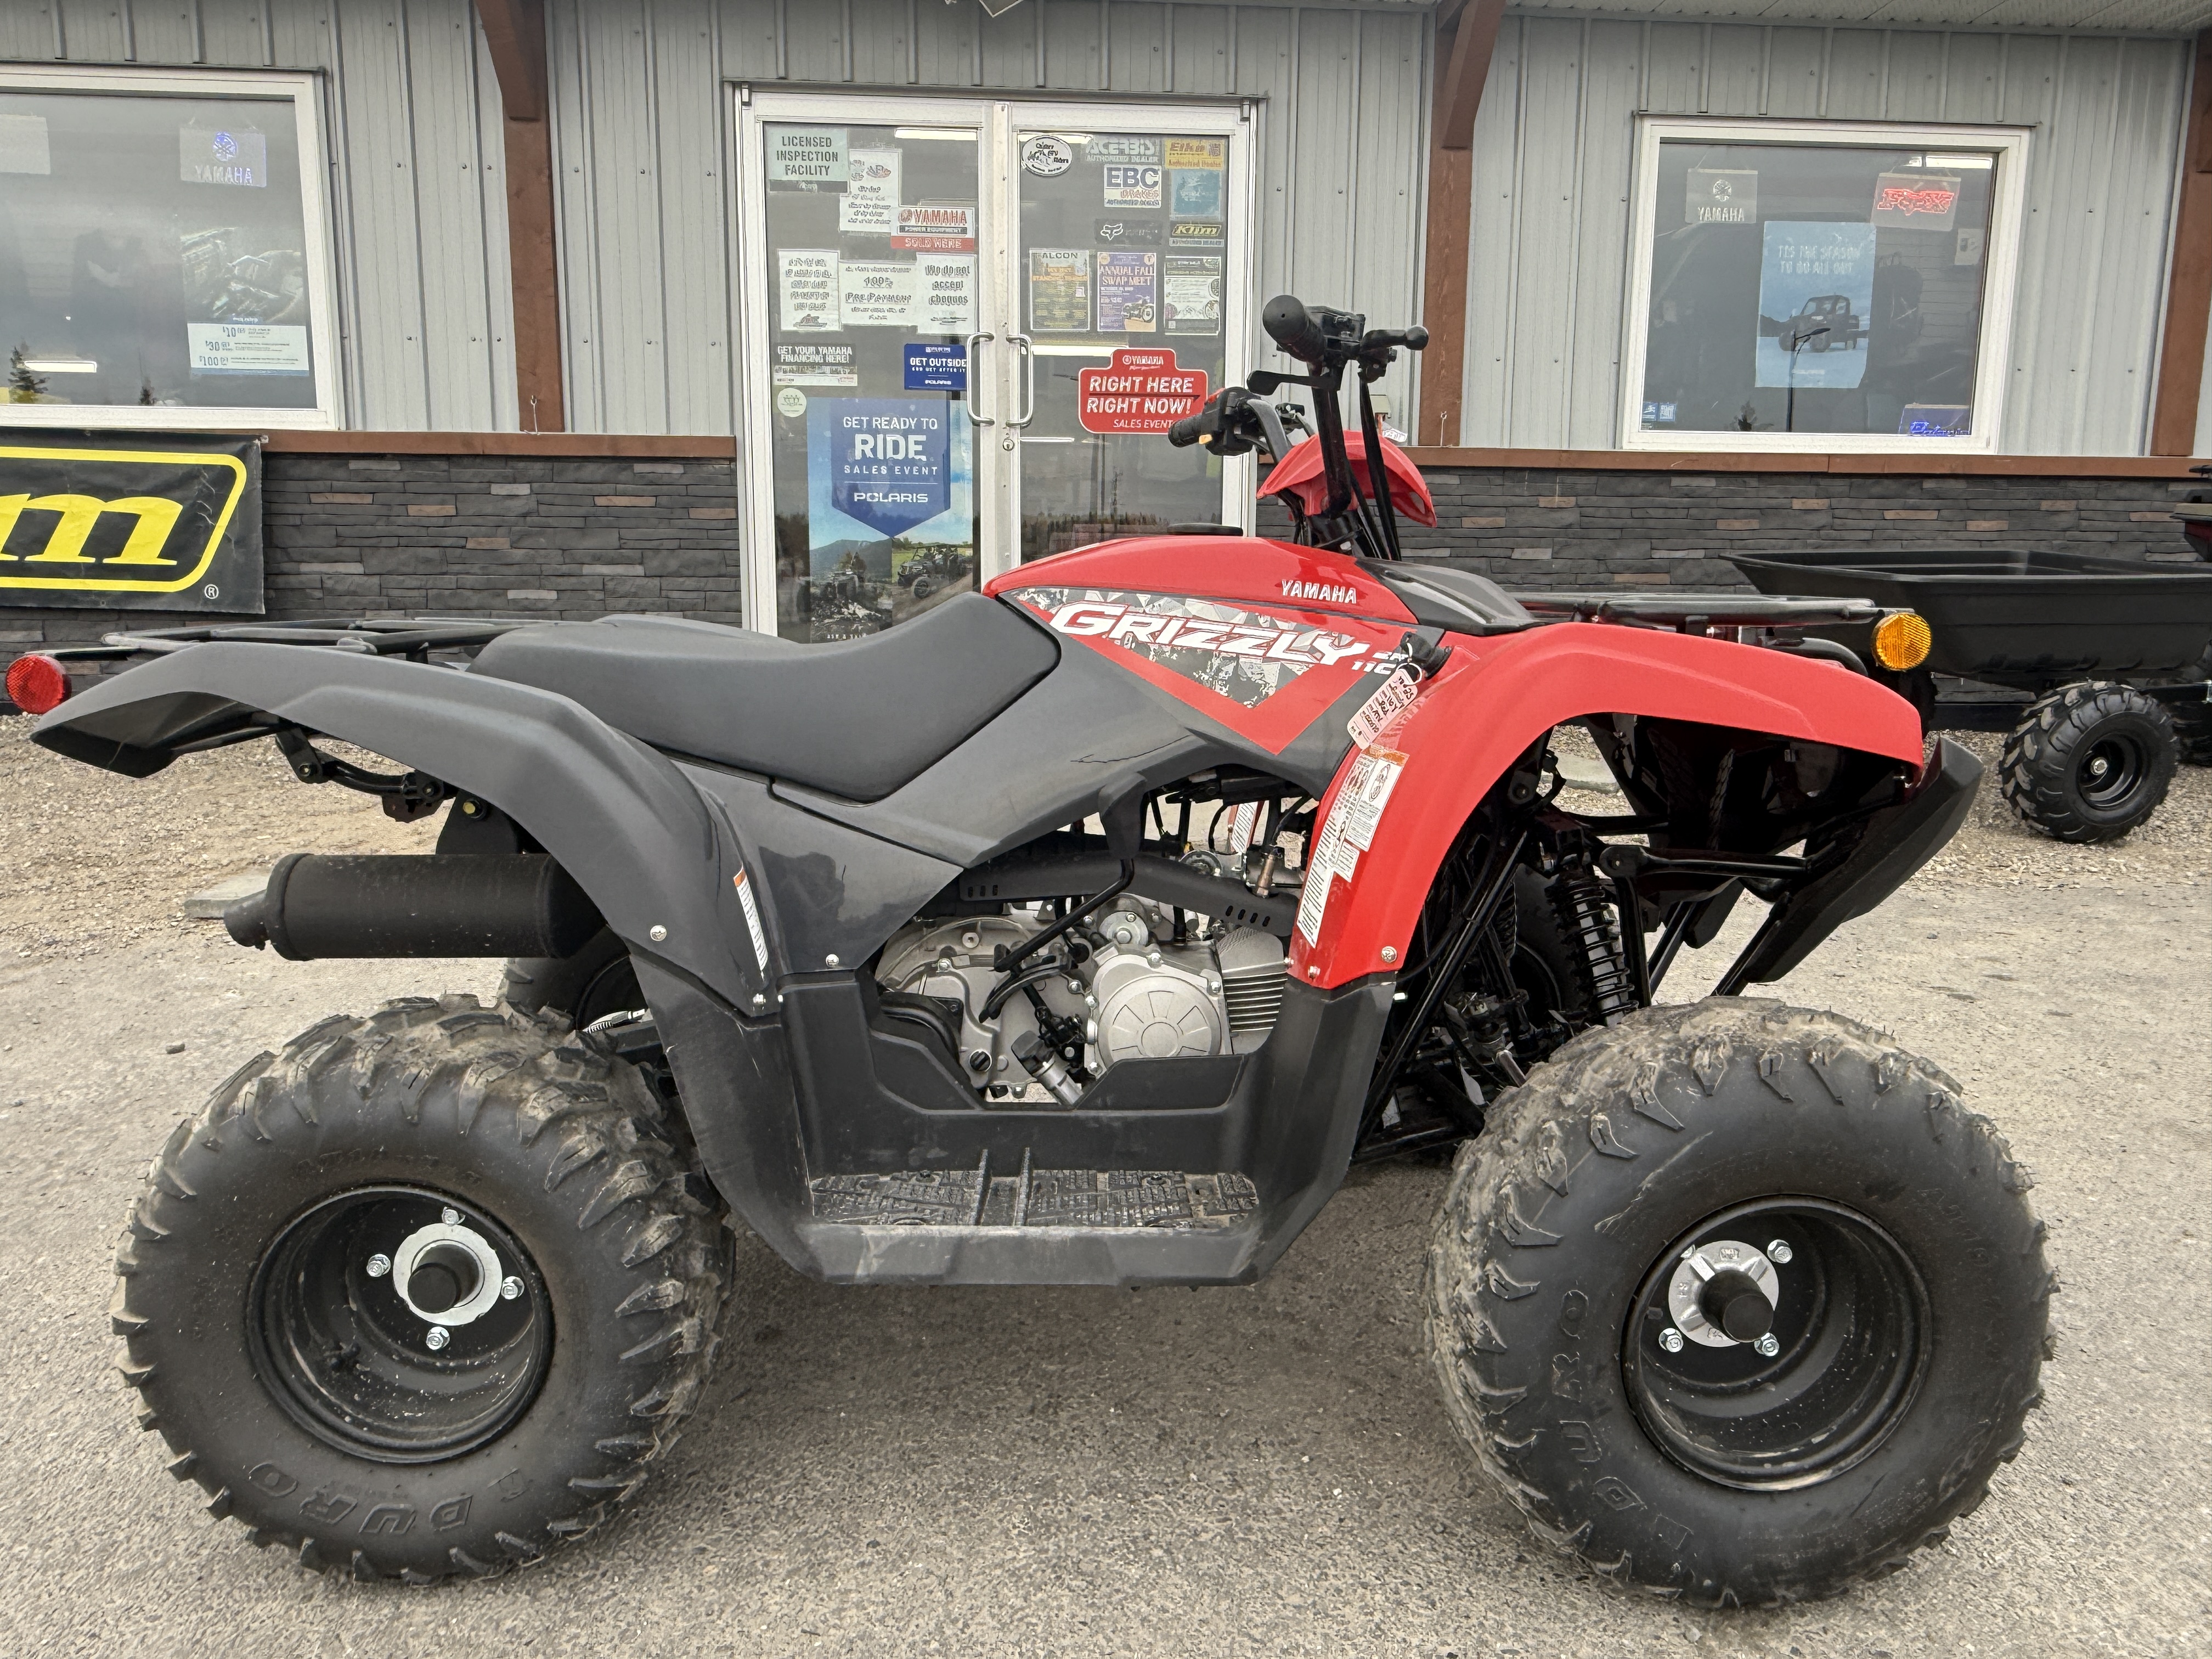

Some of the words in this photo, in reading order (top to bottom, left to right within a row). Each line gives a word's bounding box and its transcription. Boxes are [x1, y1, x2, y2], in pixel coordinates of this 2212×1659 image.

[782, 136, 832, 147] LICENSED
[776, 150, 838, 162] INSPECTION
[195, 165, 253, 185] YAMAHA
[785, 165, 830, 176] FACILITY
[1107, 166, 1159, 188] EBC
[913, 209, 967, 225] YAMAHA
[1698, 207, 1745, 222] YAMAHA
[905, 238, 932, 248] SOLD
[934, 239, 962, 249] HERE
[1135, 266, 1154, 275] FALL
[1102, 275, 1127, 285] SWAP
[777, 346, 792, 354] GET
[795, 346, 816, 354] YOUR
[817, 347, 853, 355] YAMAHA
[910, 358, 927, 366] GET
[929, 358, 967, 367] OUTSIDE
[1090, 376, 1143, 392] RIGHT
[1147, 376, 1194, 393] HERE
[1087, 397, 1141, 414] RIGHT
[1144, 398, 1192, 414] NOW!
[843, 417, 869, 428] GET
[872, 417, 917, 429] READY
[921, 417, 938, 430] TO
[1113, 419, 1141, 428] SALES
[1144, 420, 1173, 428] EVENT
[855, 433, 927, 461] RIDE
[844, 465, 887, 475] SALES
[895, 466, 938, 475] EVENT
[854, 493, 928, 503] POLARIS
[1282, 579, 1357, 604] YAMAHA
[1048, 601, 1372, 665] GRIZZLY
